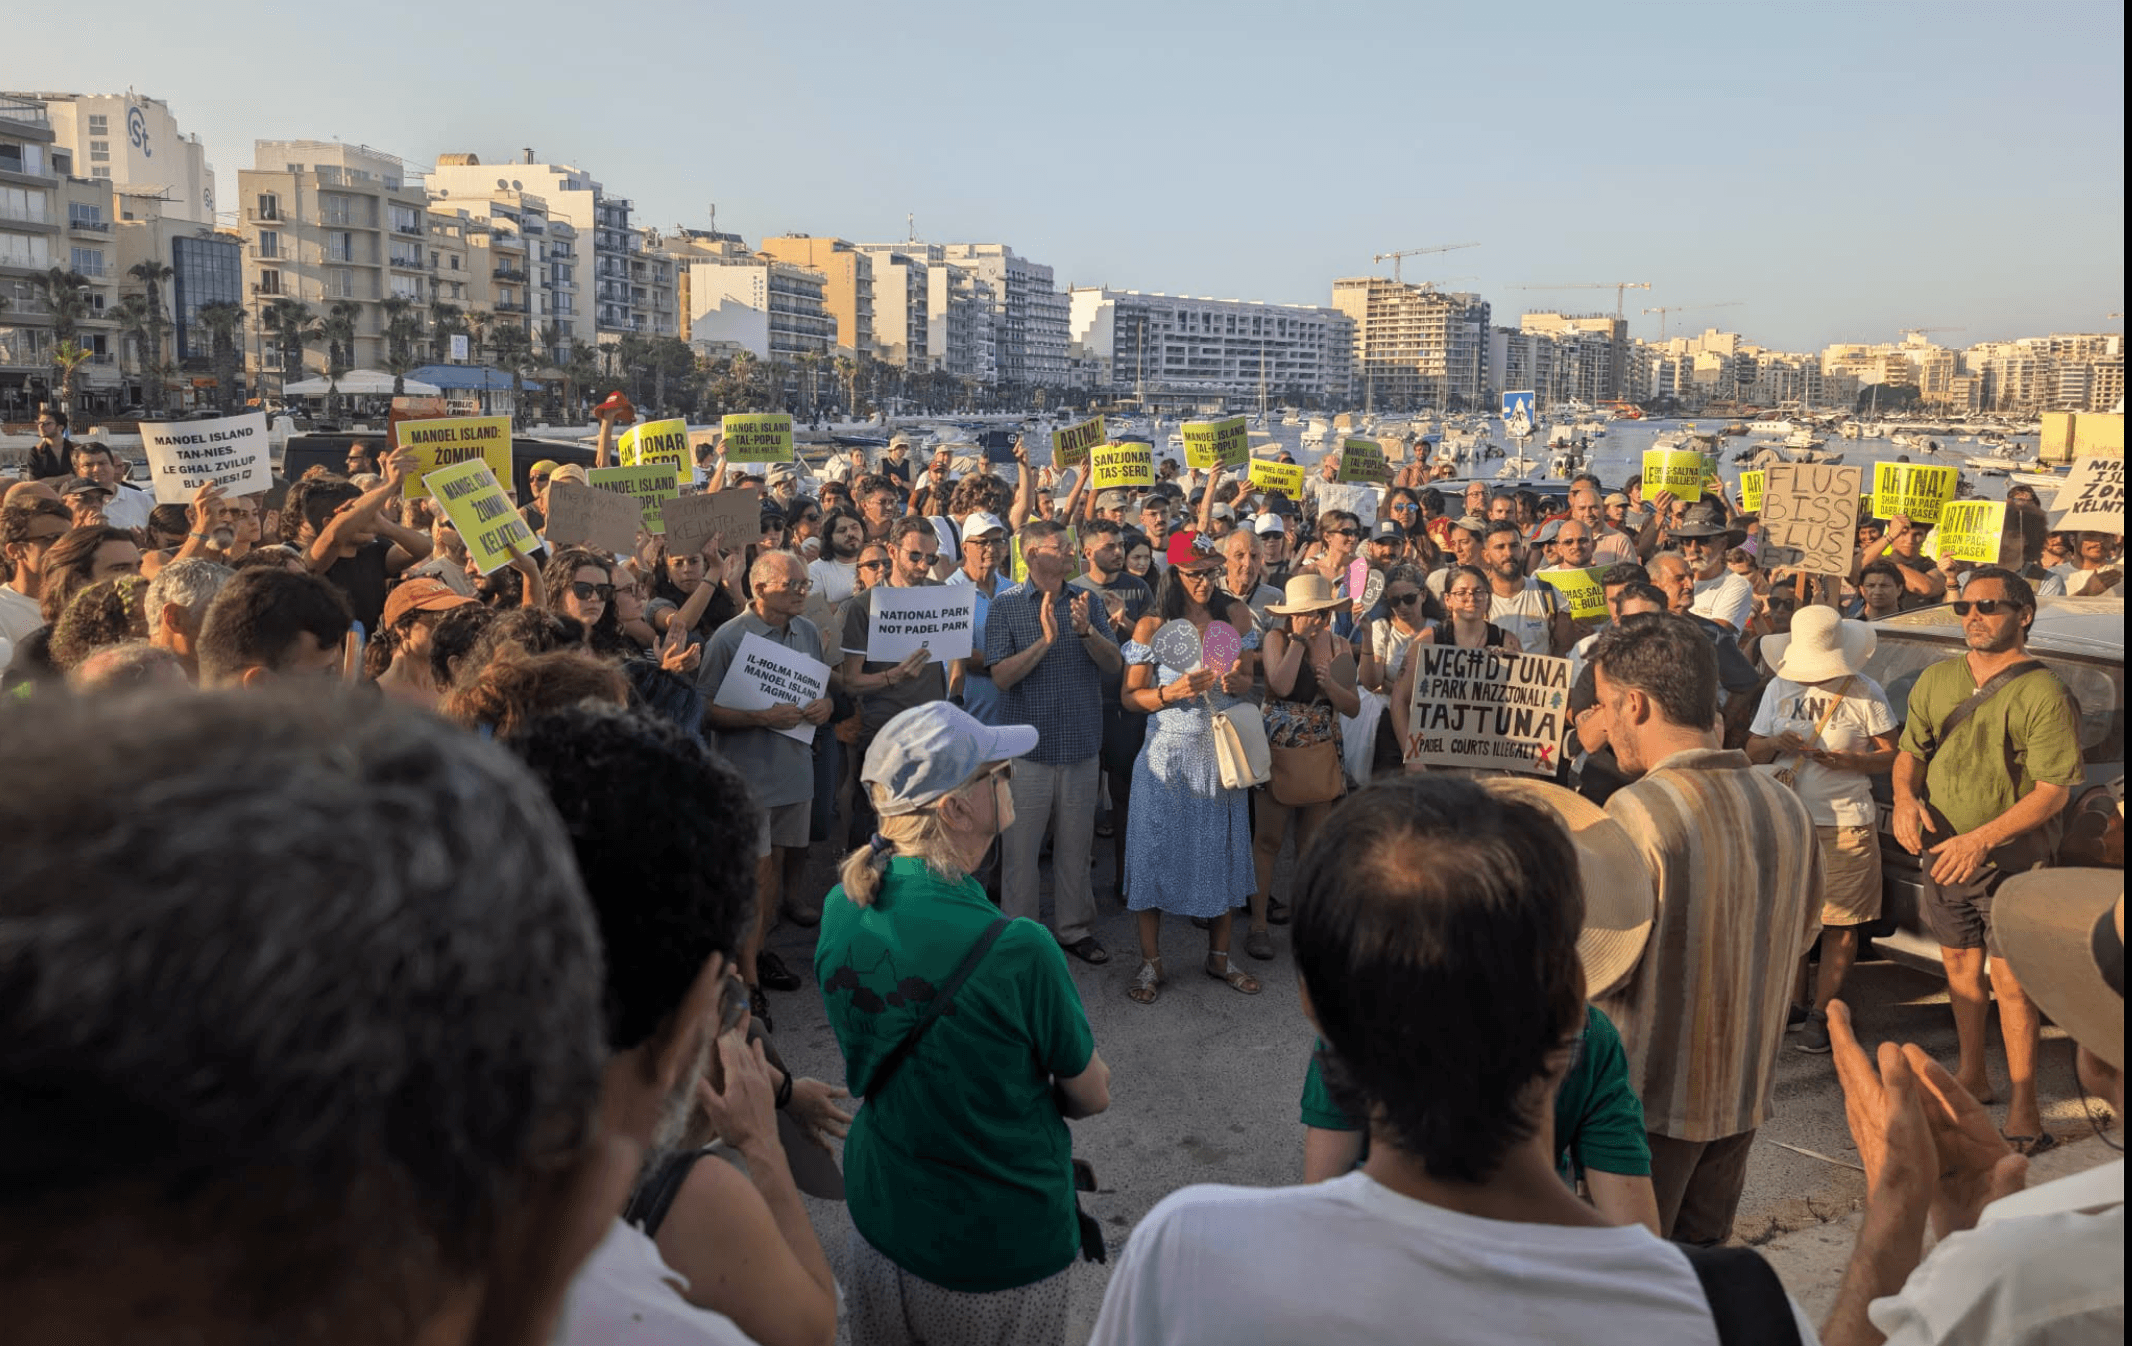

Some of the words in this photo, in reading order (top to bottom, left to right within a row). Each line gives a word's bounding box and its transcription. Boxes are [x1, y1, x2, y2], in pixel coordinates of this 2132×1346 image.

[411, 429, 457, 444] MANOEL
[460, 426, 502, 441] ISLAND:
[725, 422, 758, 433] MANOEL
[760, 422, 790, 432] ISLAND
[1184, 431, 1216, 442] MANOEL
[1217, 425, 1246, 441] ISLAND
[154, 435, 207, 446] MANOEL
[209, 427, 254, 443] ISLAND
[735, 434, 781, 445] TAL-POPLU
[176, 446, 237, 460] TAN-NIES.
[620, 433, 686, 467] SANJONAR
[1193, 440, 1238, 455] TAL-POPLU
[1094, 452, 1152, 467] SANZJONAR
[2088, 460, 2124, 471] MA
[162, 466, 176, 474] LE
[1099, 465, 1149, 480] TAS-SERQ
[639, 476, 675, 492] ISLAND
[1769, 466, 1857, 496] FLUS
[1882, 467, 1947, 498] ARTNA!
[1763, 493, 1853, 530] BISS
[880, 610, 938, 620] NATIONAL
[941, 606, 970, 618] PARK
[878, 625, 903, 634] NOT
[904, 624, 940, 634] PADEL
[941, 621, 969, 632] PARK
[743, 664, 787, 688] MANOEL
[788, 681, 818, 700] ISLAND
[1430, 679, 1468, 700] PARK
[1471, 682, 1547, 708] NAZZJONALI
[1417, 703, 1557, 742] TAJTUNA
[1450, 738, 1491, 757] COURTS
